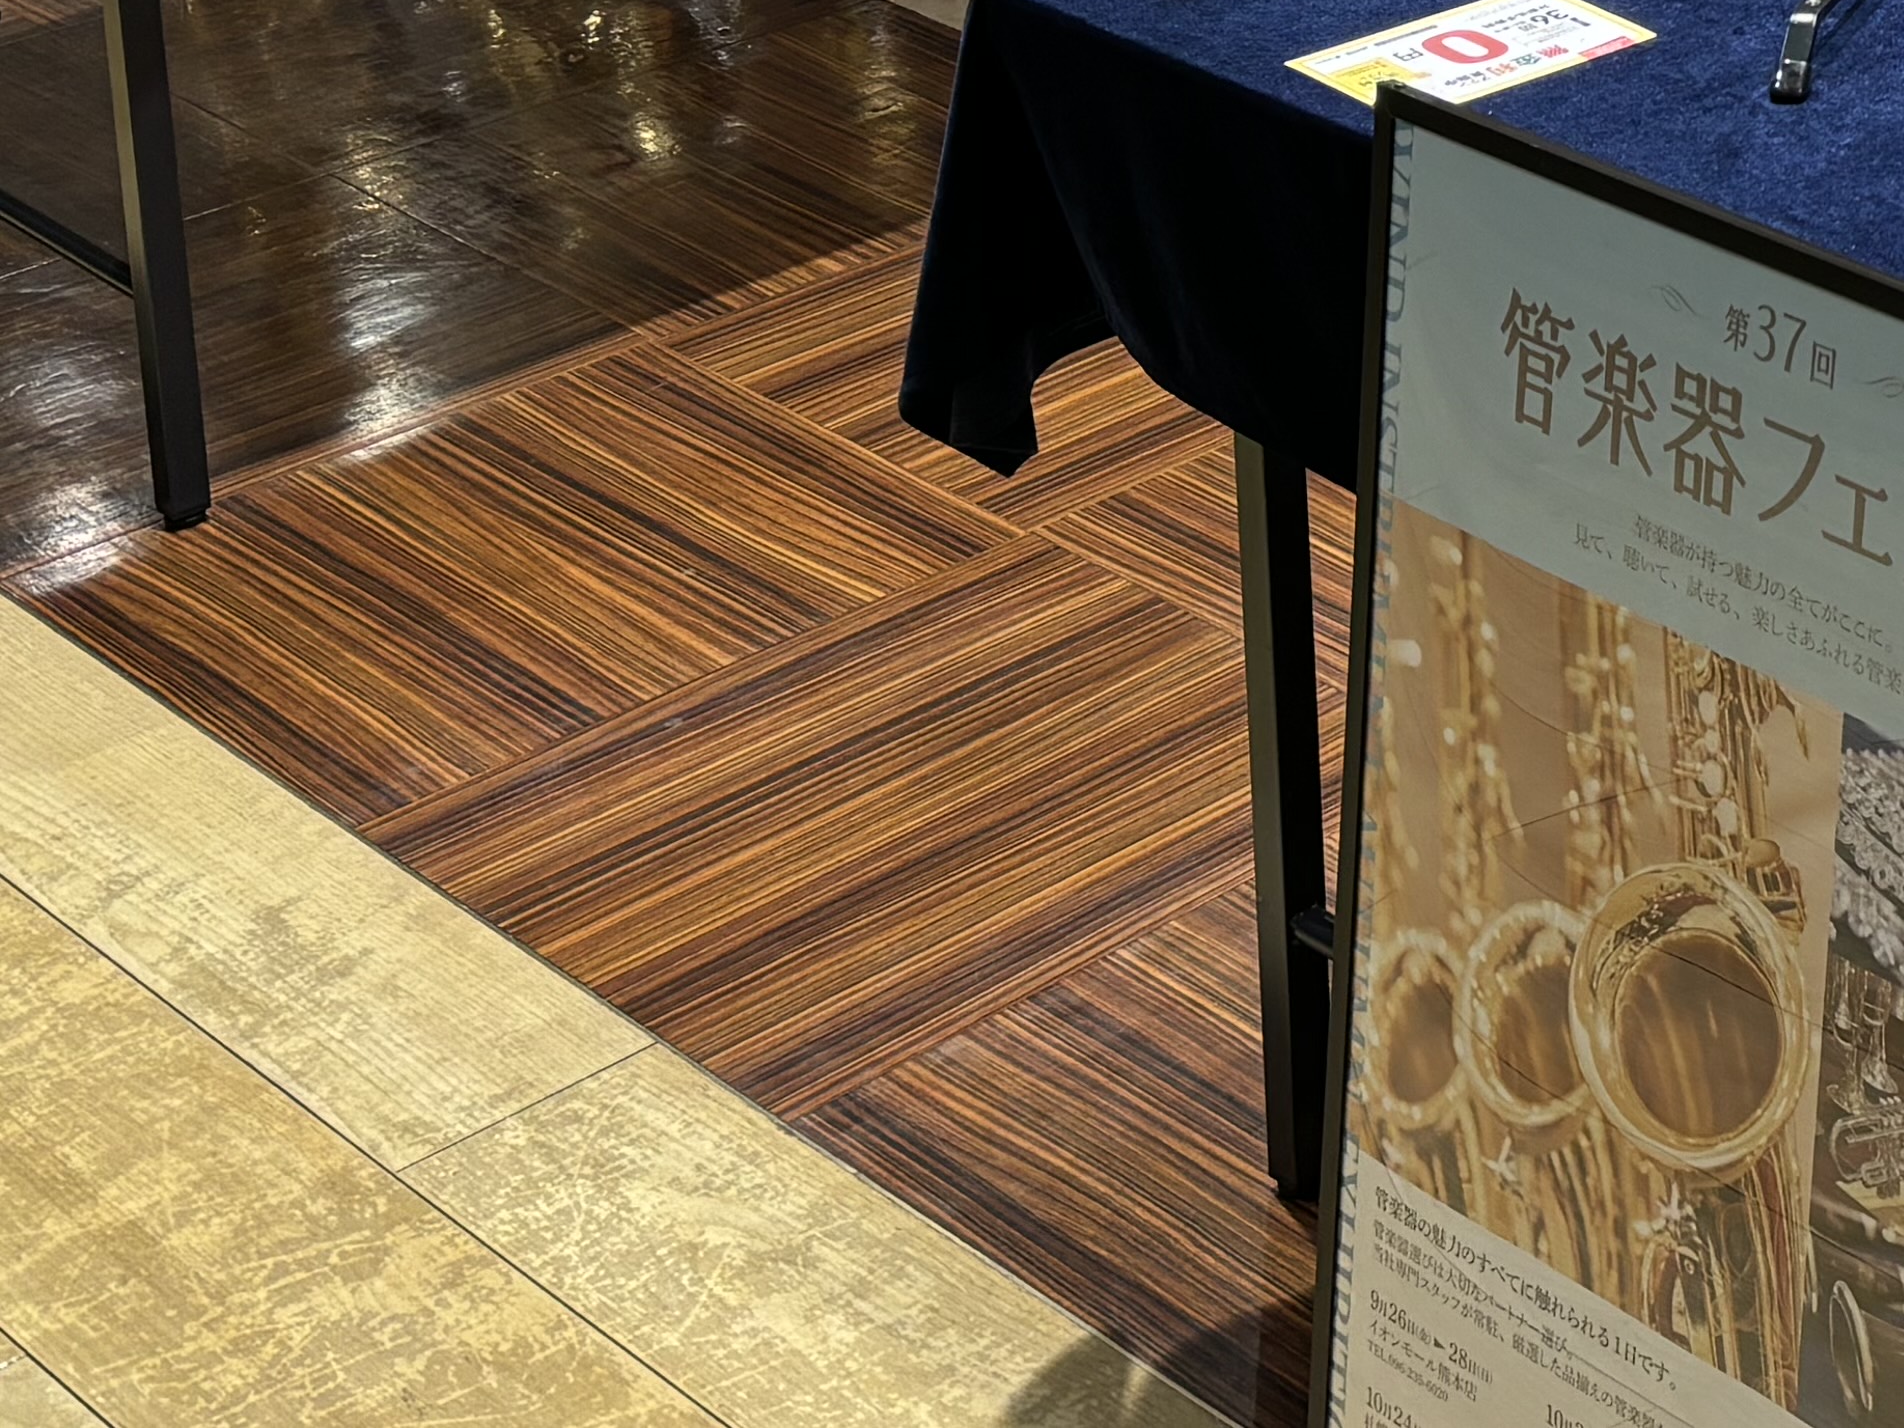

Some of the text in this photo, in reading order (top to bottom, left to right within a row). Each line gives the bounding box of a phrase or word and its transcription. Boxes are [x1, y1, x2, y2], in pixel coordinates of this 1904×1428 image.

[1421, 29, 1509, 65] 0
[1724, 304, 1838, 390] 第37回
[1635, 514, 1894, 654] 管楽器が持つ魅力の全てがここに。
[1375, 1186, 1677, 1392] 管楽器の魅力のすべてに触れられる1日です。
[1370, 1320, 1477, 1402] イオンモール熊本店
